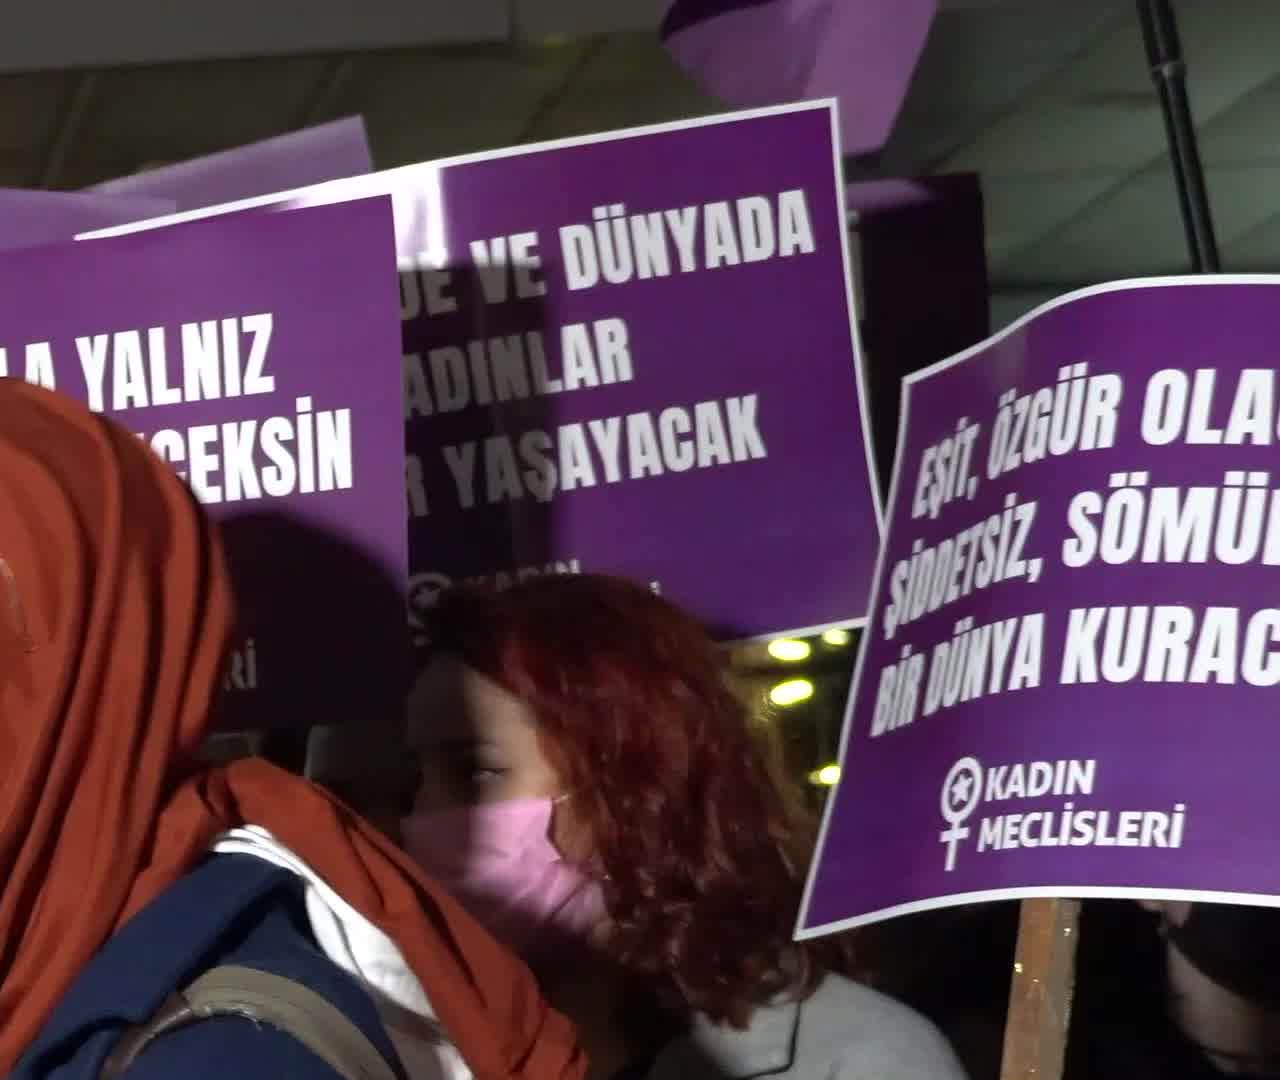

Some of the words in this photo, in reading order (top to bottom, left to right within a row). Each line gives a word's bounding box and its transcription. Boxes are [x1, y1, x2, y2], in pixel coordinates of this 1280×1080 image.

[469, 231, 547, 305] VE
[558, 188, 817, 291] DÜNYADA
[74, 312, 277, 414] YALNIZ
[137, 396, 354, 504] CEKSİN
[441, 394, 769, 509] YAŞAYACAK
[911, 416, 979, 521] EŞİT,
[986, 361, 1124, 481] ÖZGÜR
[1142, 367, 1280, 446] OLA
[884, 492, 1044, 640] ŞİDDETSİZ,
[869, 644, 925, 738] BİR
[922, 612, 1045, 717] DÜNYA
[976, 802, 1186, 853] MECLİSLERİ
[983, 758, 1096, 803] KADIN
